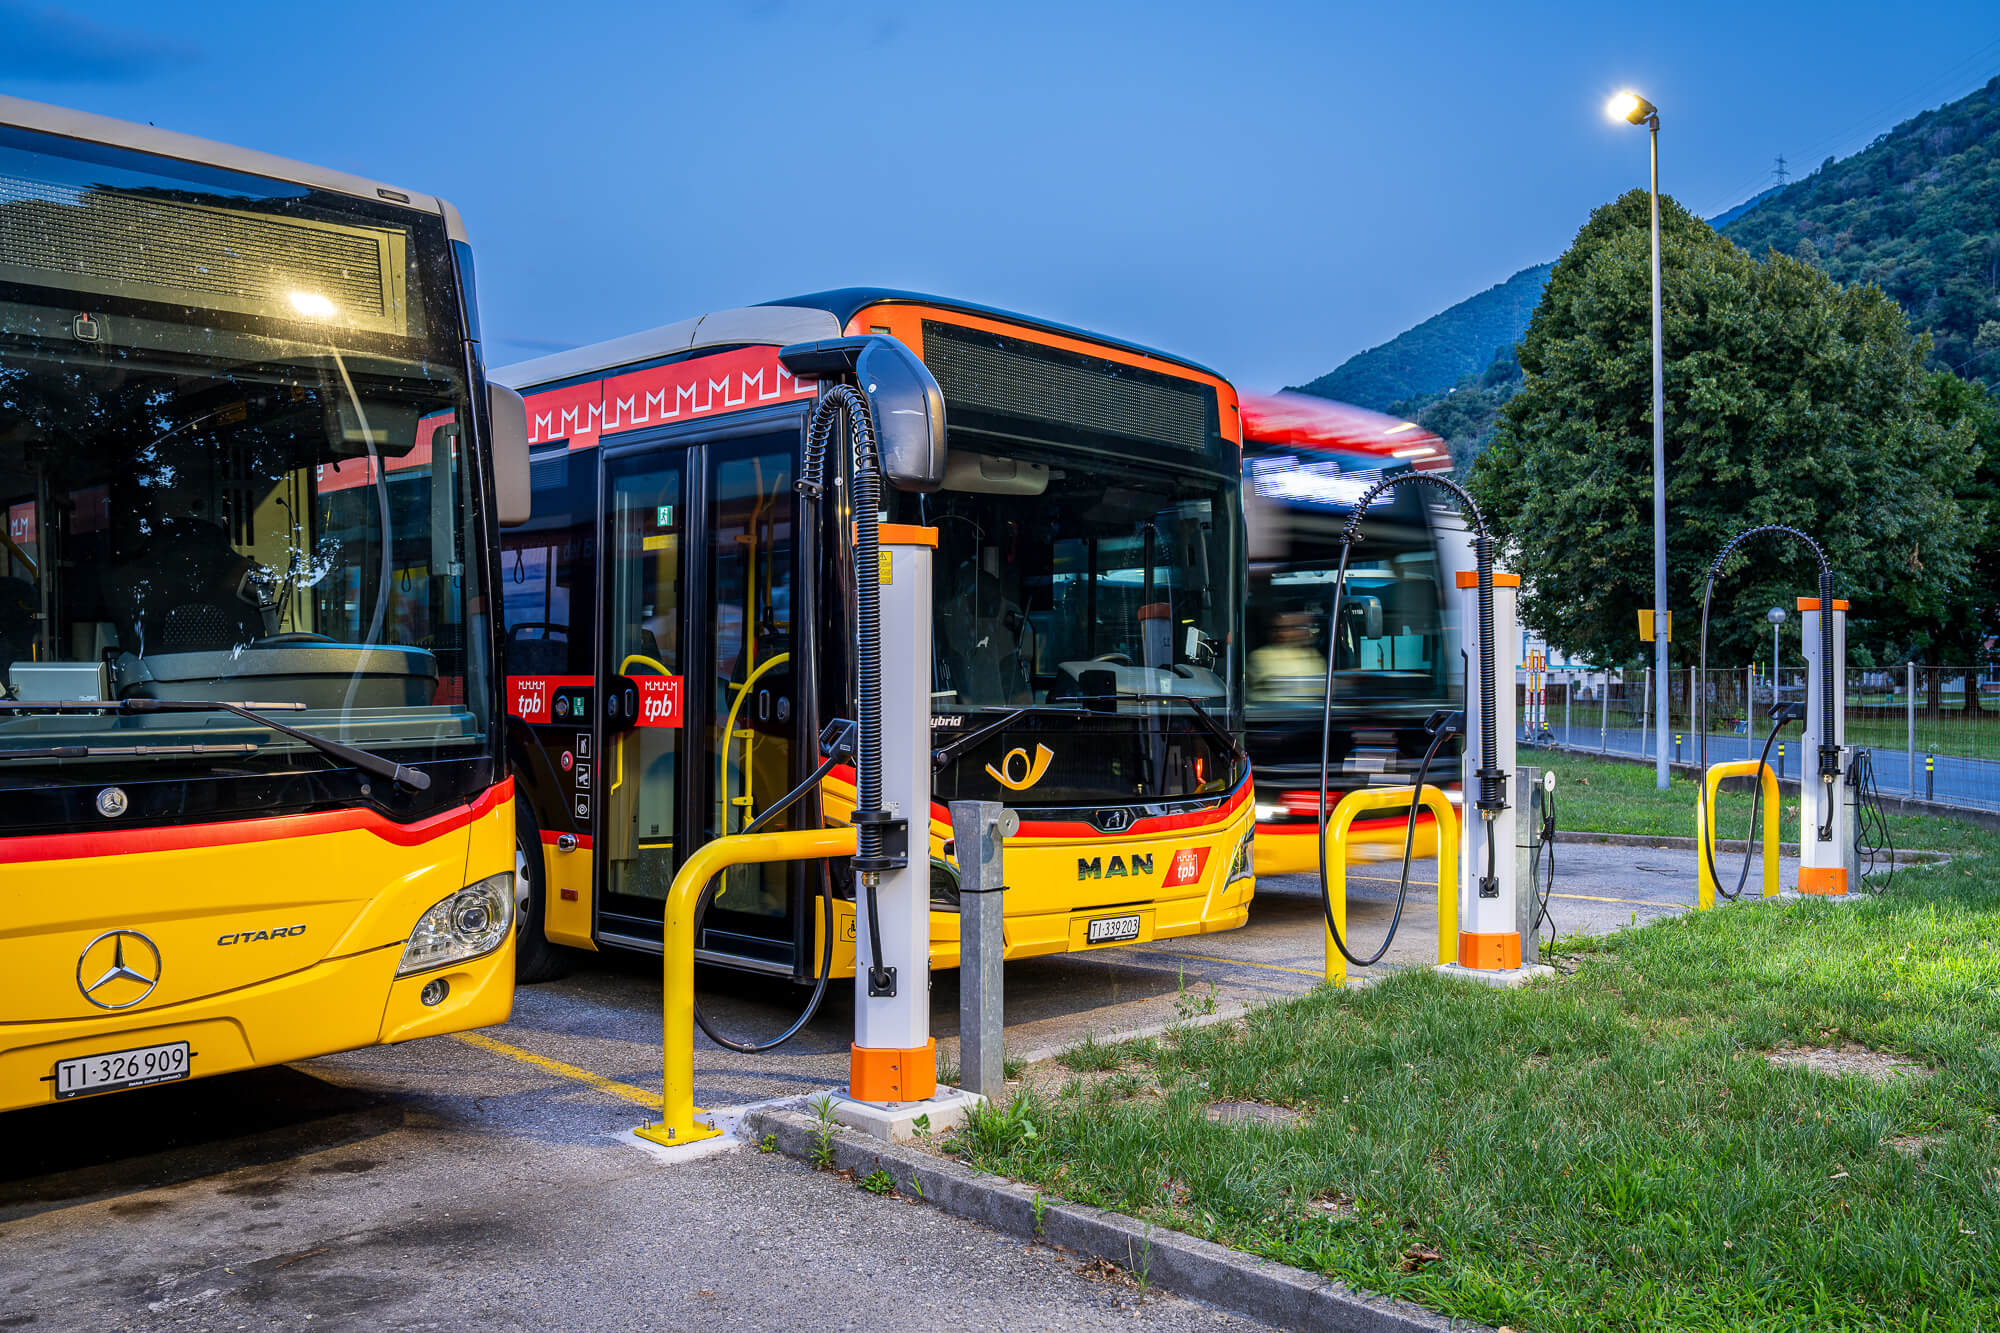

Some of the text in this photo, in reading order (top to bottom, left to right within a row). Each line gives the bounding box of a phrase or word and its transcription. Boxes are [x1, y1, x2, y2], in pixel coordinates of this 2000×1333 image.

[518, 692, 541, 719] tpb
[645, 694, 673, 722] tpb
[930, 716, 962, 728] ybrid
[1078, 853, 1154, 881] MAN
[1177, 862, 1195, 882] tpb
[217, 924, 306, 946] CITARO
